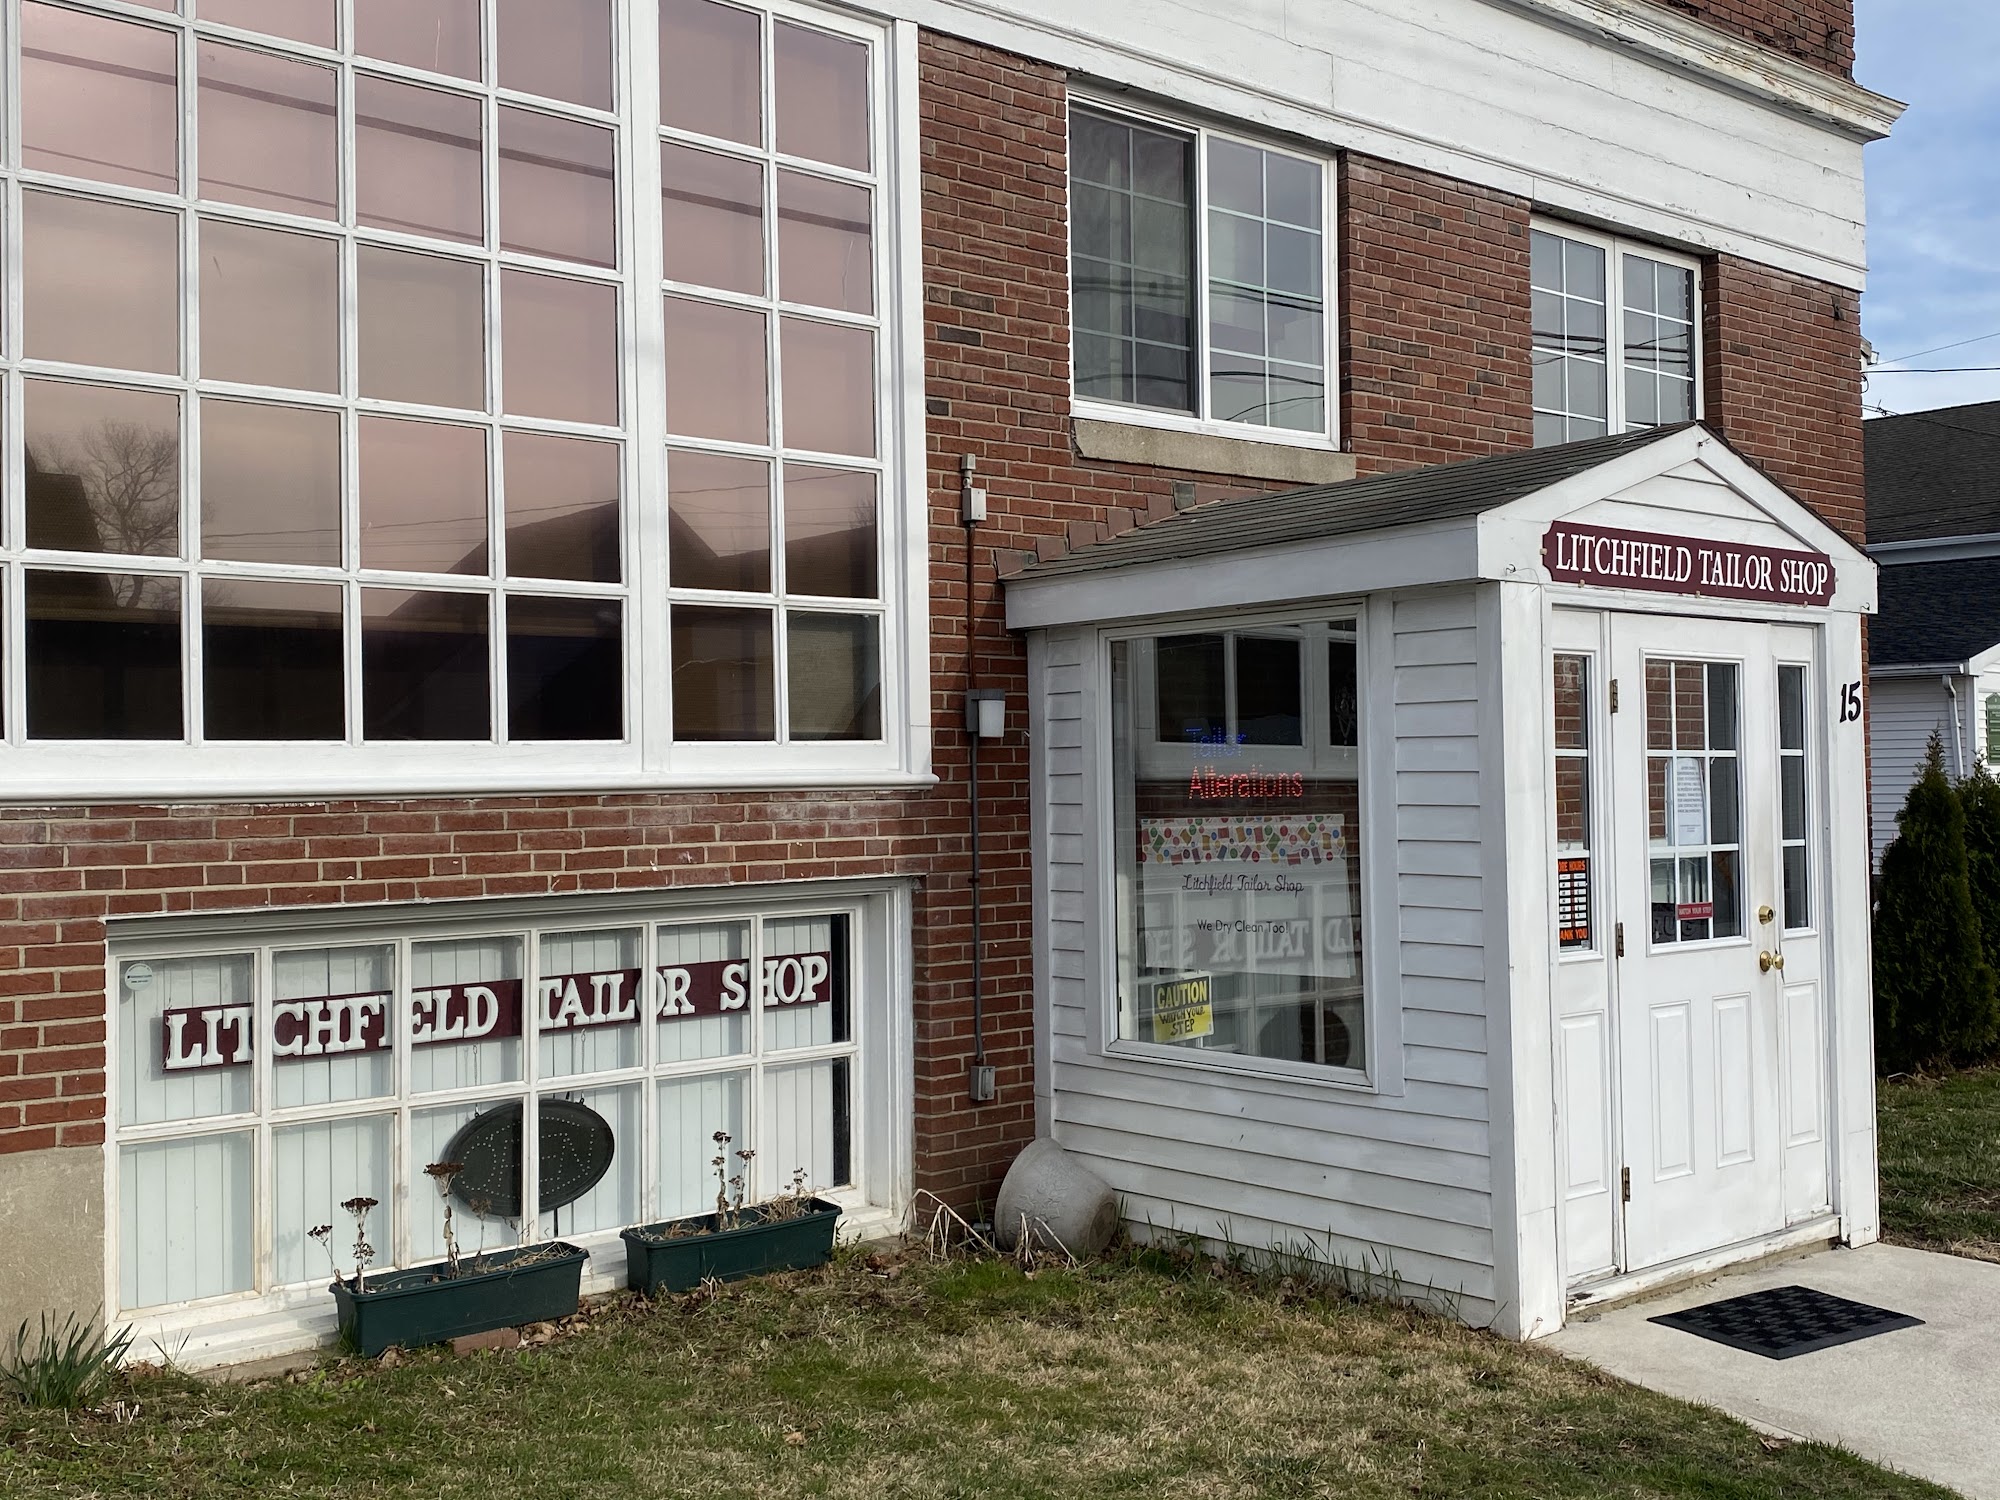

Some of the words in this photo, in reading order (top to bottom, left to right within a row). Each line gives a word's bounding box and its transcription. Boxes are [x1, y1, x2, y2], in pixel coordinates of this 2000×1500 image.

[1556, 532, 1692, 583] LITCHFIELD
[1698, 548, 1775, 592] TAILOR
[1780, 558, 1829, 596] SHOP
[1840, 680, 1861, 723] 15
[1186, 726, 1247, 758] Tailor
[1188, 763, 1303, 799] Alterations
[1182, 874, 1234, 896] Litchfield
[1237, 874, 1271, 891] Tailor
[1274, 874, 1304, 898] Shop
[1197, 919, 1212, 931] We
[1215, 920, 1231, 934] Dry
[1235, 920, 1264, 932] Clean
[1266, 921, 1288, 933] Too!
[1157, 980, 1207, 1009] CAUTION
[1170, 1018, 1195, 1036] STEP
